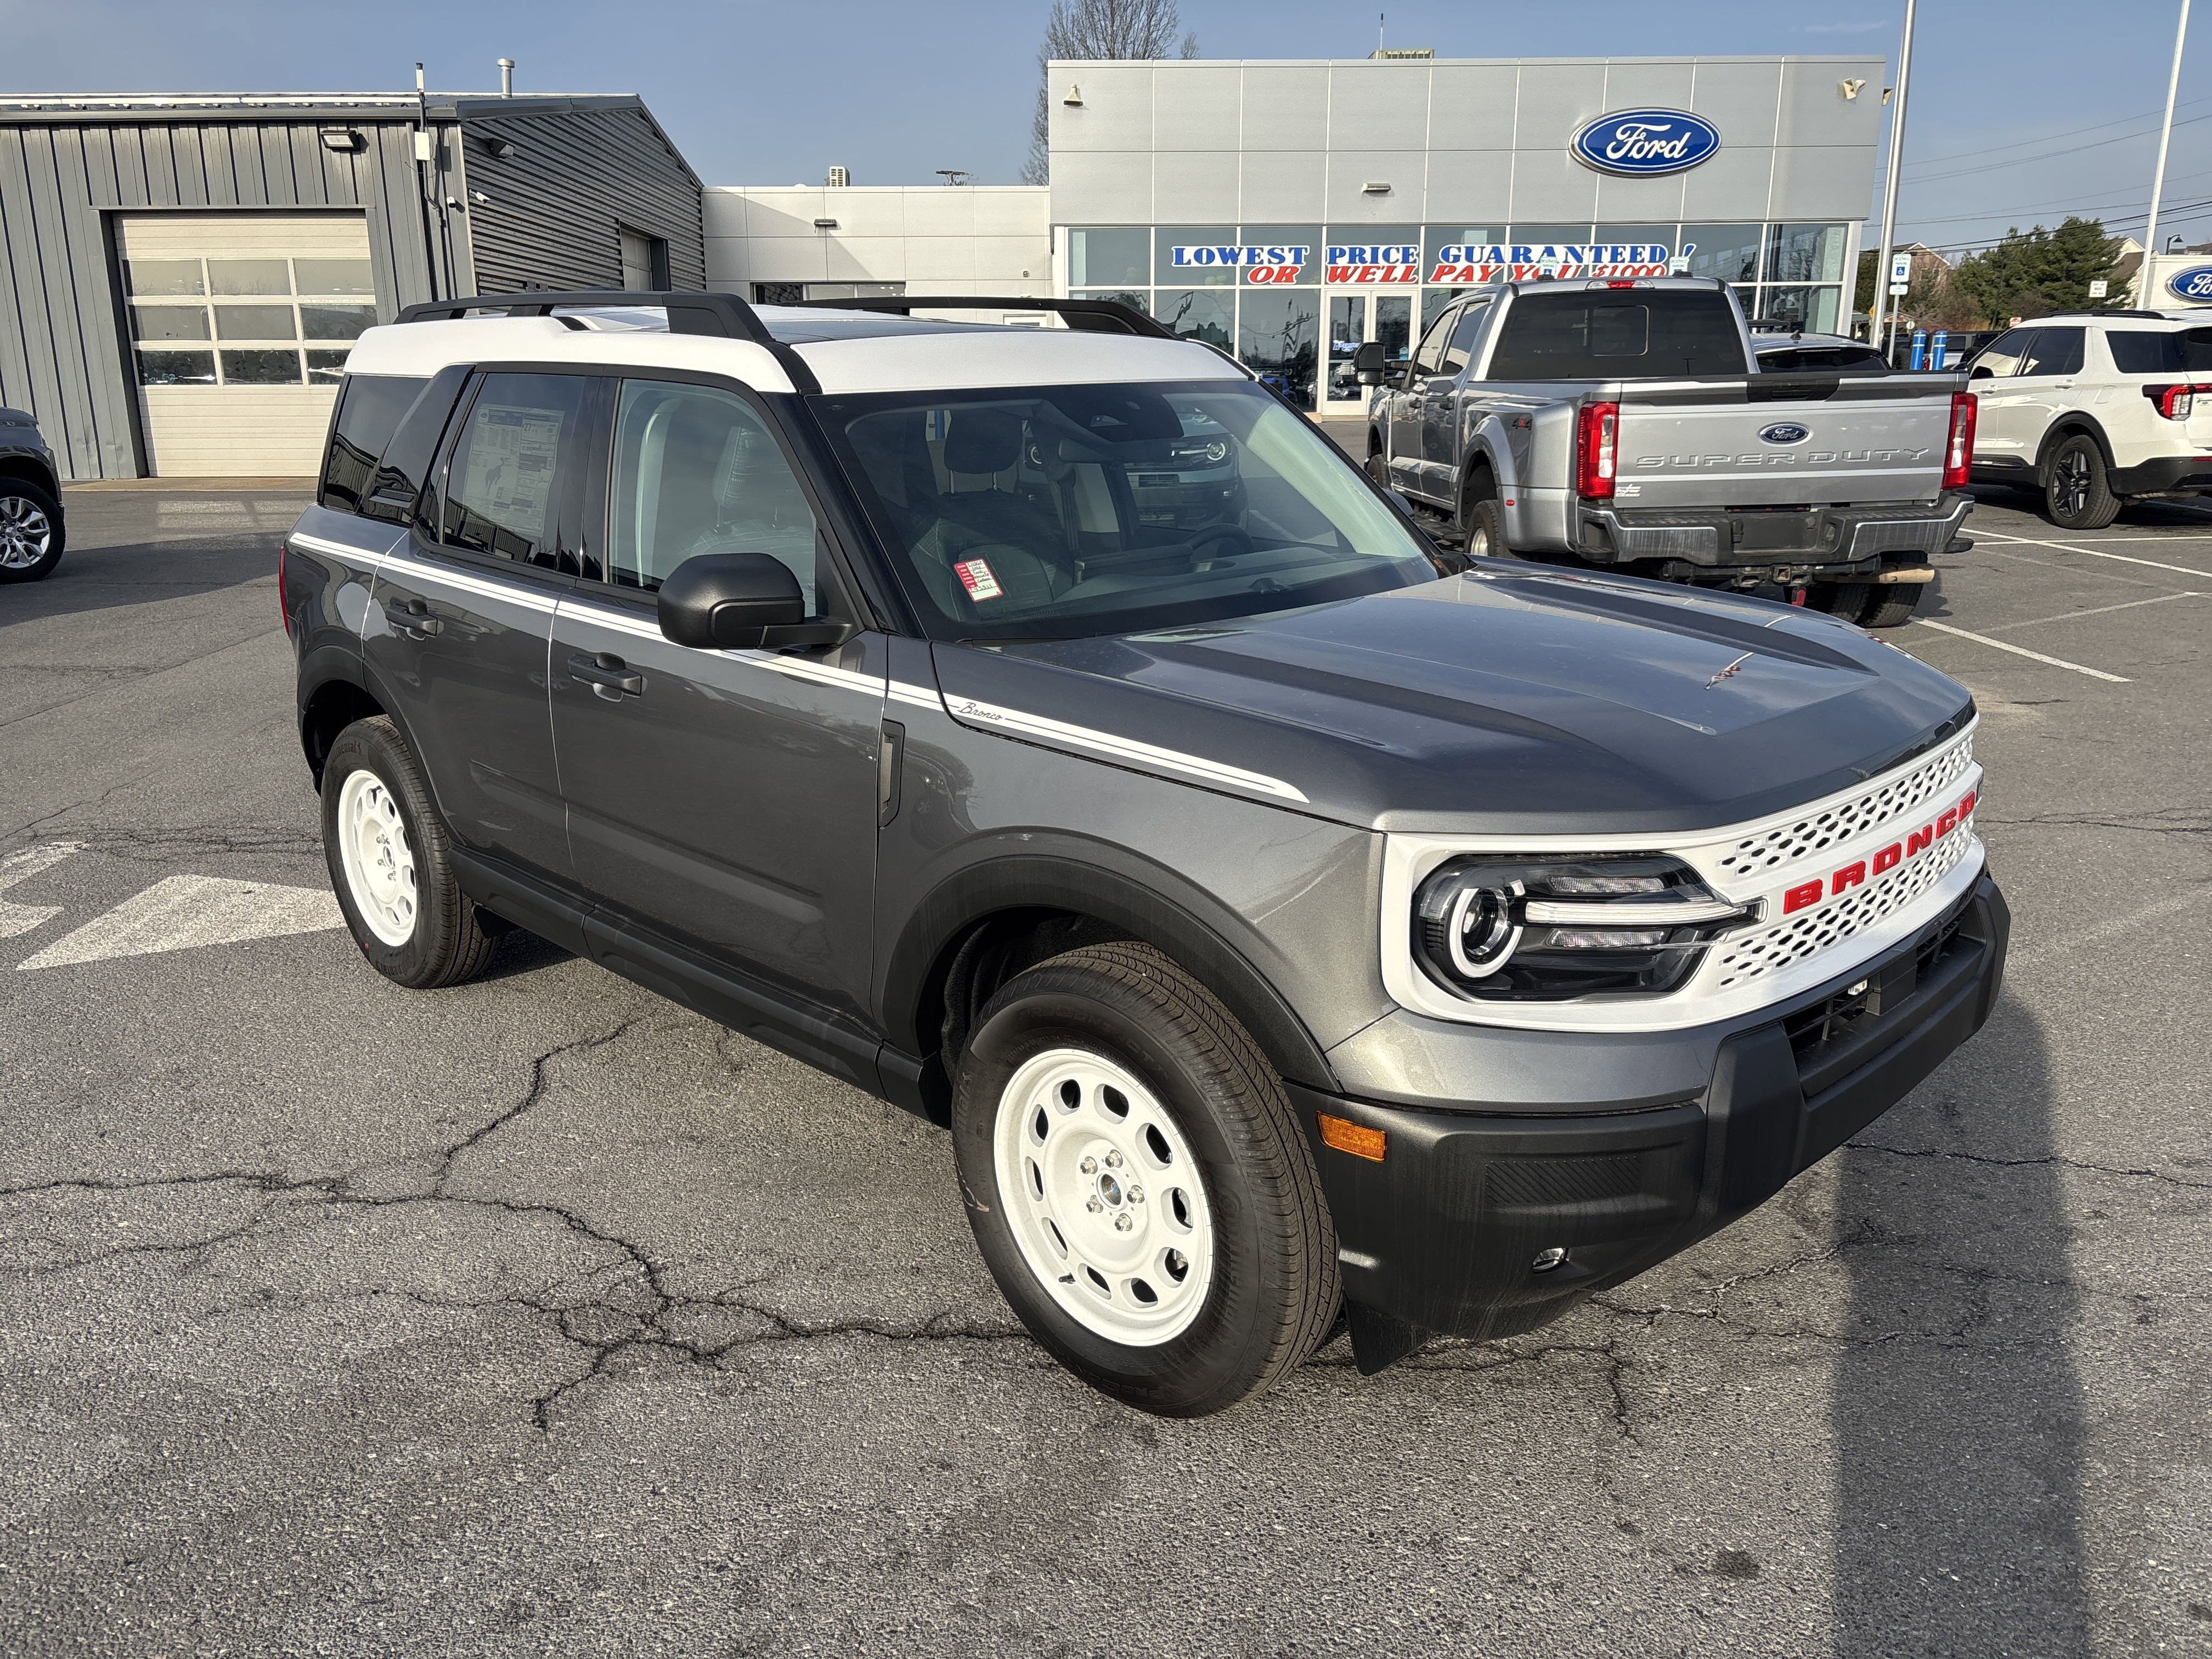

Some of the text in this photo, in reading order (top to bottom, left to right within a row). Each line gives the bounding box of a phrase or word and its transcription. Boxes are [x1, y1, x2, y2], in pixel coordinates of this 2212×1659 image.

[1606, 123, 1692, 160] Ford
[1172, 247, 1307, 266] LOWEST
[1327, 246, 1418, 264] PRICE
[1249, 266, 1301, 284] OR
[1327, 266, 1417, 283] WE'LL
[1429, 265, 1501, 283] PAY
[1592, 264, 1666, 277] $1000
[1771, 428, 1799, 439] Ford
[1636, 448, 1930, 469] SUPER DUTY
[957, 702, 1003, 720] Bronco
[1783, 791, 1976, 915] BRONCO
